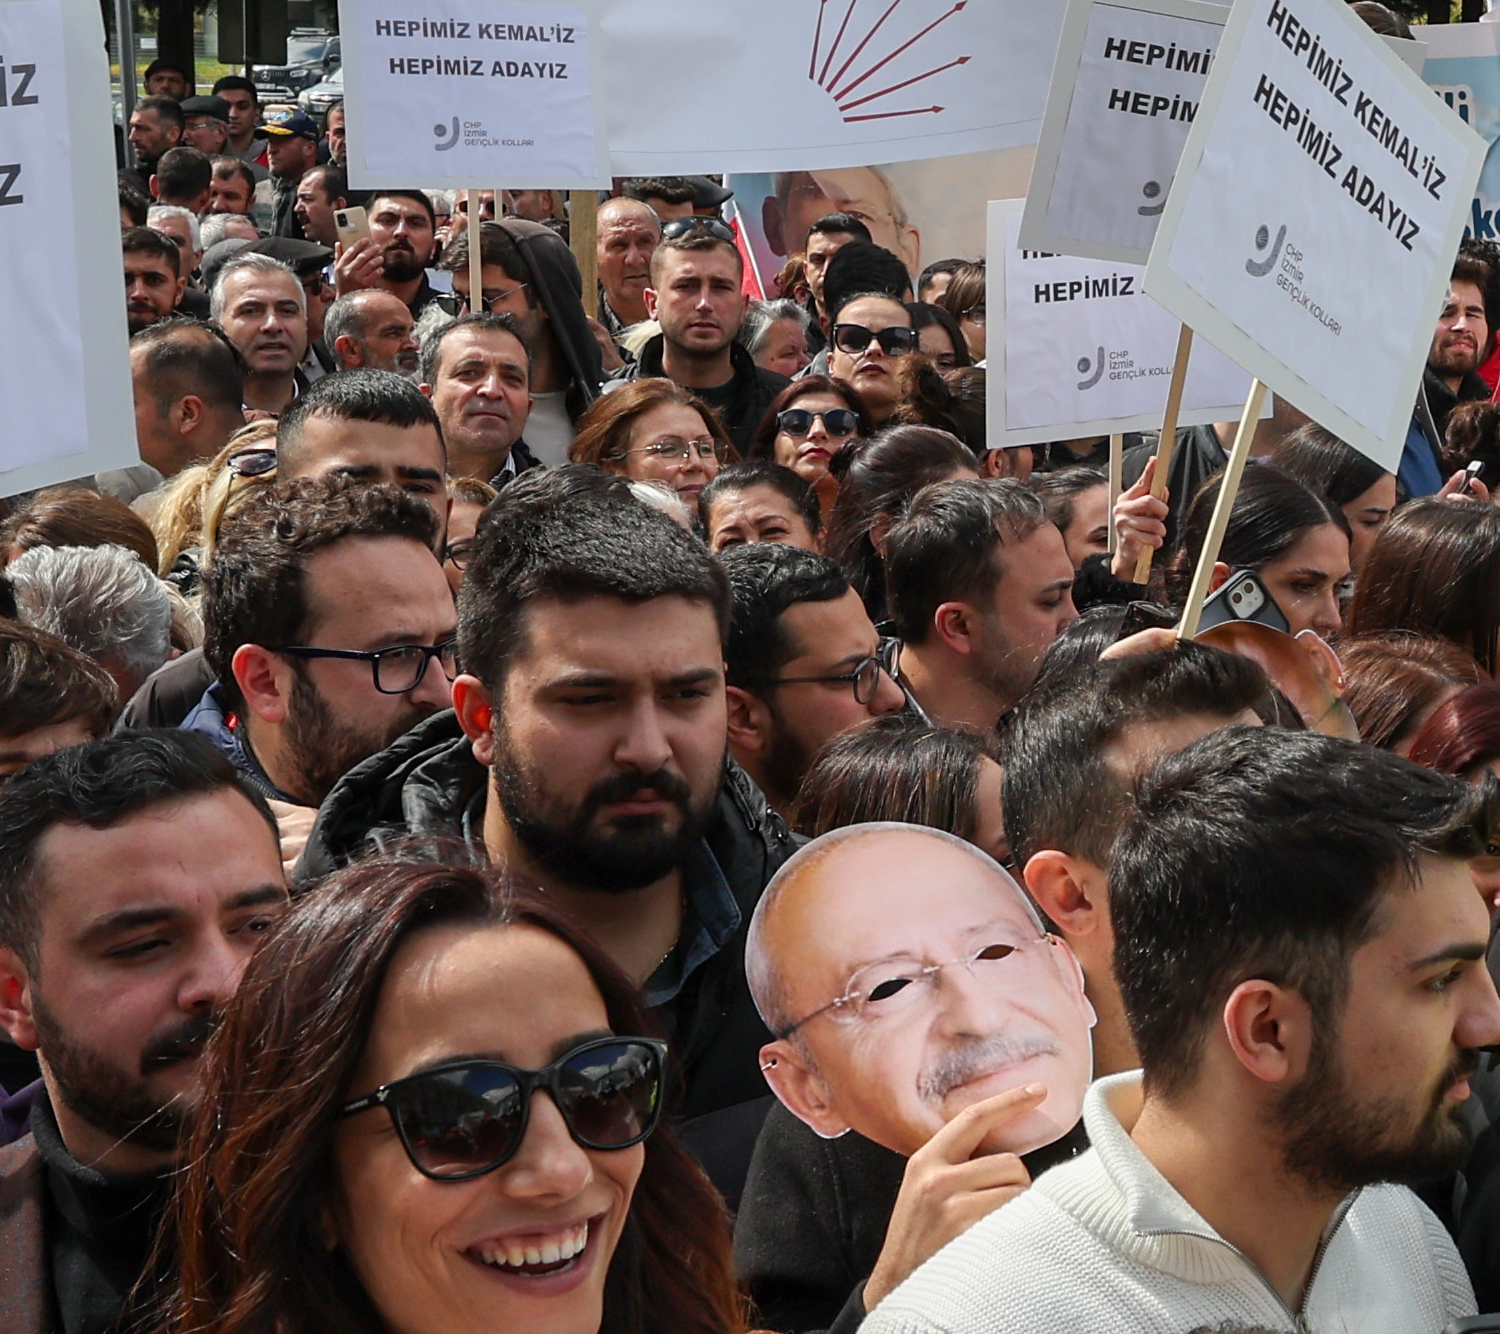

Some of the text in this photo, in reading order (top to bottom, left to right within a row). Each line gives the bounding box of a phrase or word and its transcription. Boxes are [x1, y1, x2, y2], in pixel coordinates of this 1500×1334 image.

[376, 18, 575, 43] HEPİMİZ KEMAL'İZ
[389, 55, 568, 79] HEPİMİZ ADAYIZ
[1104, 37, 1216, 75] HEPİMİ
[1353, 90, 1447, 201] KEMAL'İZ
[1253, 73, 1420, 251] HEPİMİZ ADAYIZ
[1286, 243, 1303, 263] CHP
[1034, 273, 1134, 303] HEPİMİZ
[1308, 304, 1341, 336] KOLLARI
[1109, 350, 1129, 359] CHP
[1149, 367, 1173, 376] KOLL
